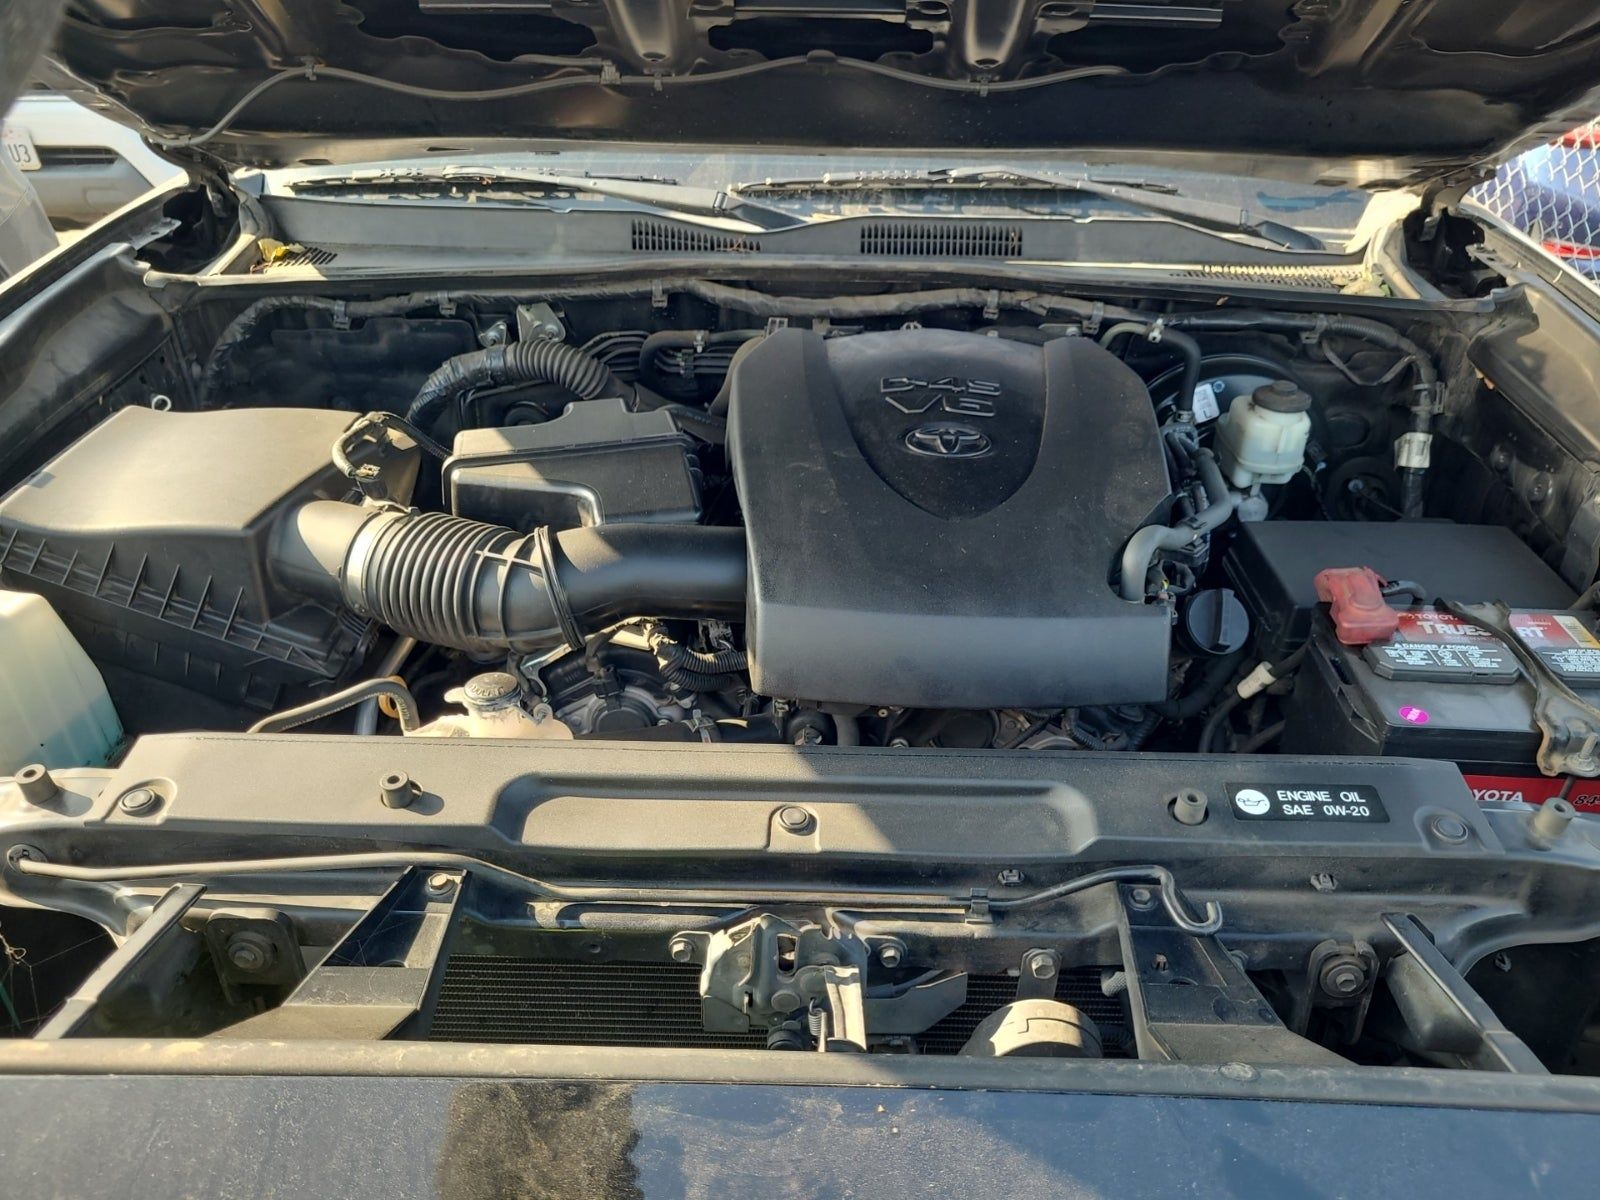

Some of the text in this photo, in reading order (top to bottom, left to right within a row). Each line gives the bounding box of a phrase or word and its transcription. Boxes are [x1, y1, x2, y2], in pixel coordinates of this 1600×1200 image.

[885, 393, 996, 417] V6
[1415, 613, 1459, 621] TOYOT
[1276, 790, 1366, 803] ENGINE OIL
[1472, 789, 1524, 802] YOTA
[1282, 804, 1370, 817] SAE 0W-20
